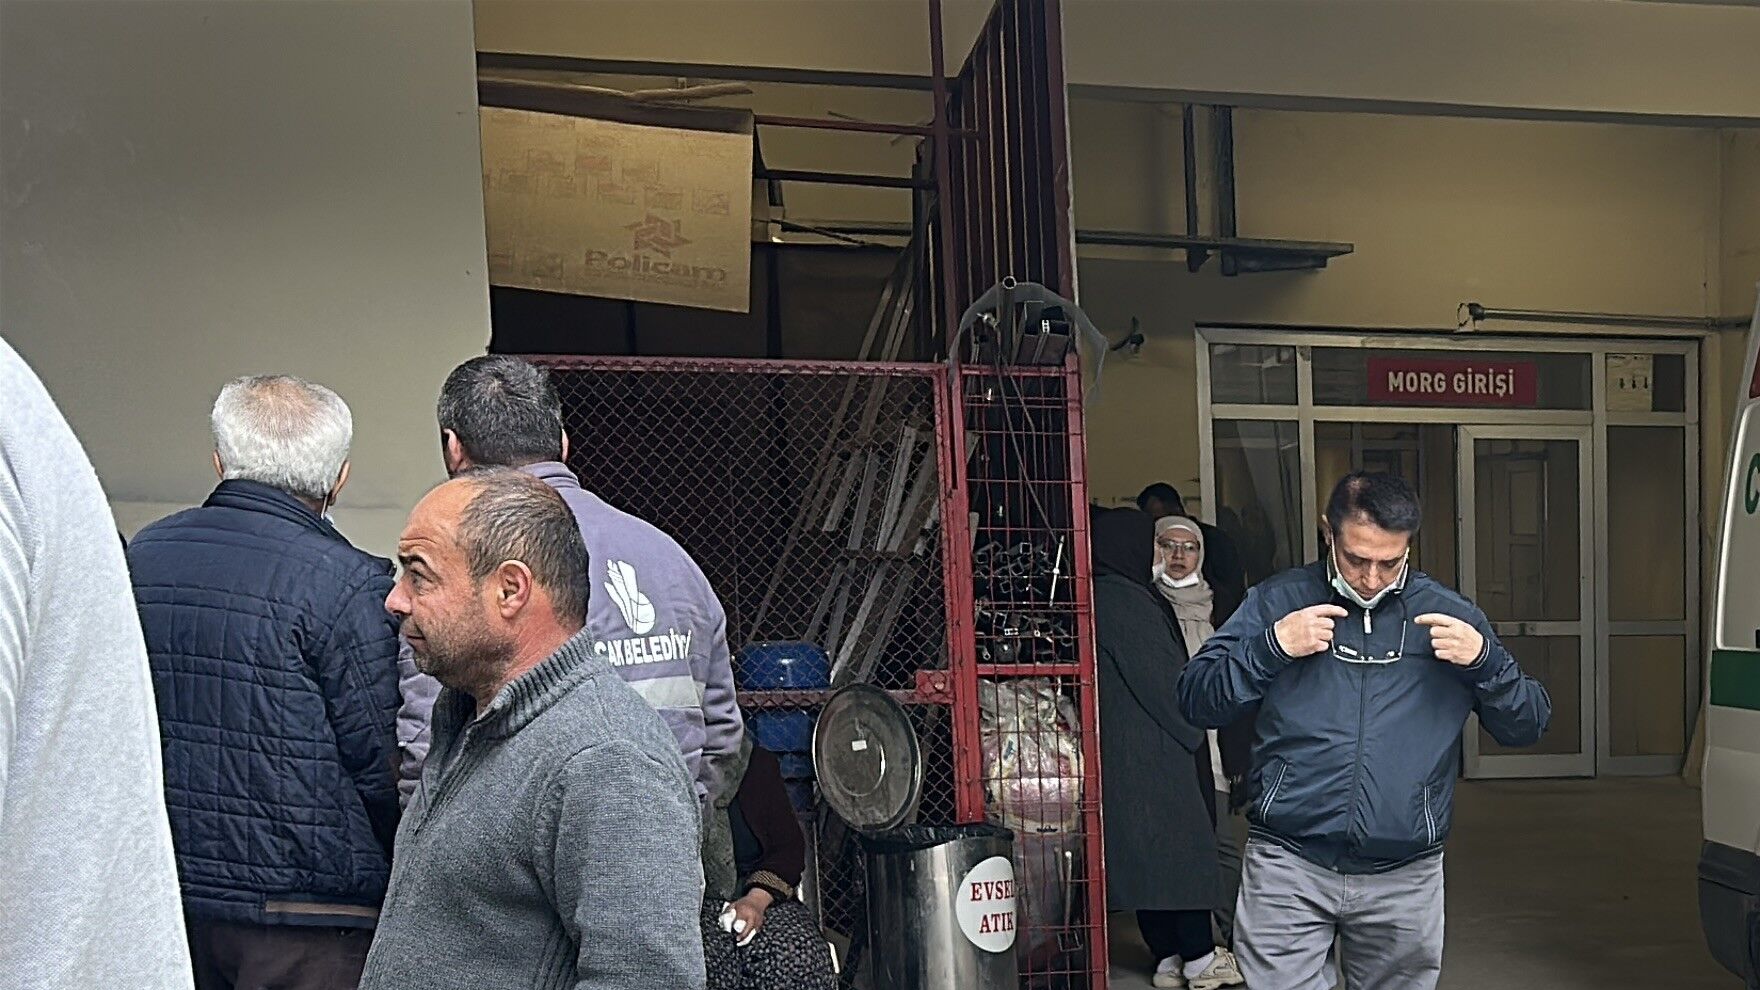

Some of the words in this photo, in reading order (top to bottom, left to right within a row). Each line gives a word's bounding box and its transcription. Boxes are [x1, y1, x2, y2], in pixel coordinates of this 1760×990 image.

[1388, 371, 1447, 393] MORG
[1453, 367, 1514, 398] GİRİŞİ
[979, 911, 1014, 934] ATIK
